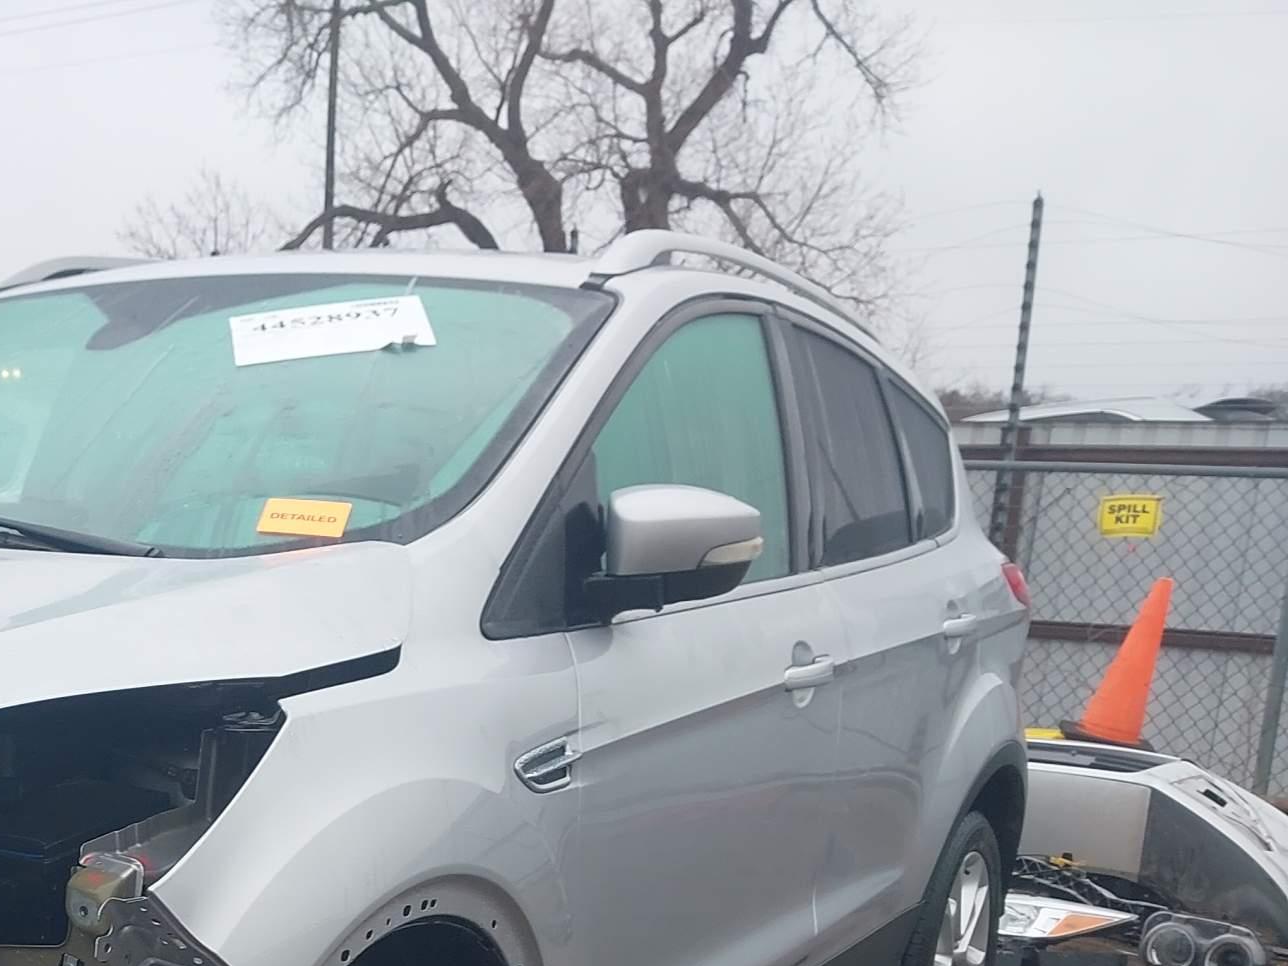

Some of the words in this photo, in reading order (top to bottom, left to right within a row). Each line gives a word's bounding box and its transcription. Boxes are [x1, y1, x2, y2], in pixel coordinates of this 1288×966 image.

[253, 307, 399, 332] 44528937
[1108, 504, 1150, 515] SPILL
[270, 512, 337, 524] DETAILED
[1114, 514, 1140, 525] KIT
